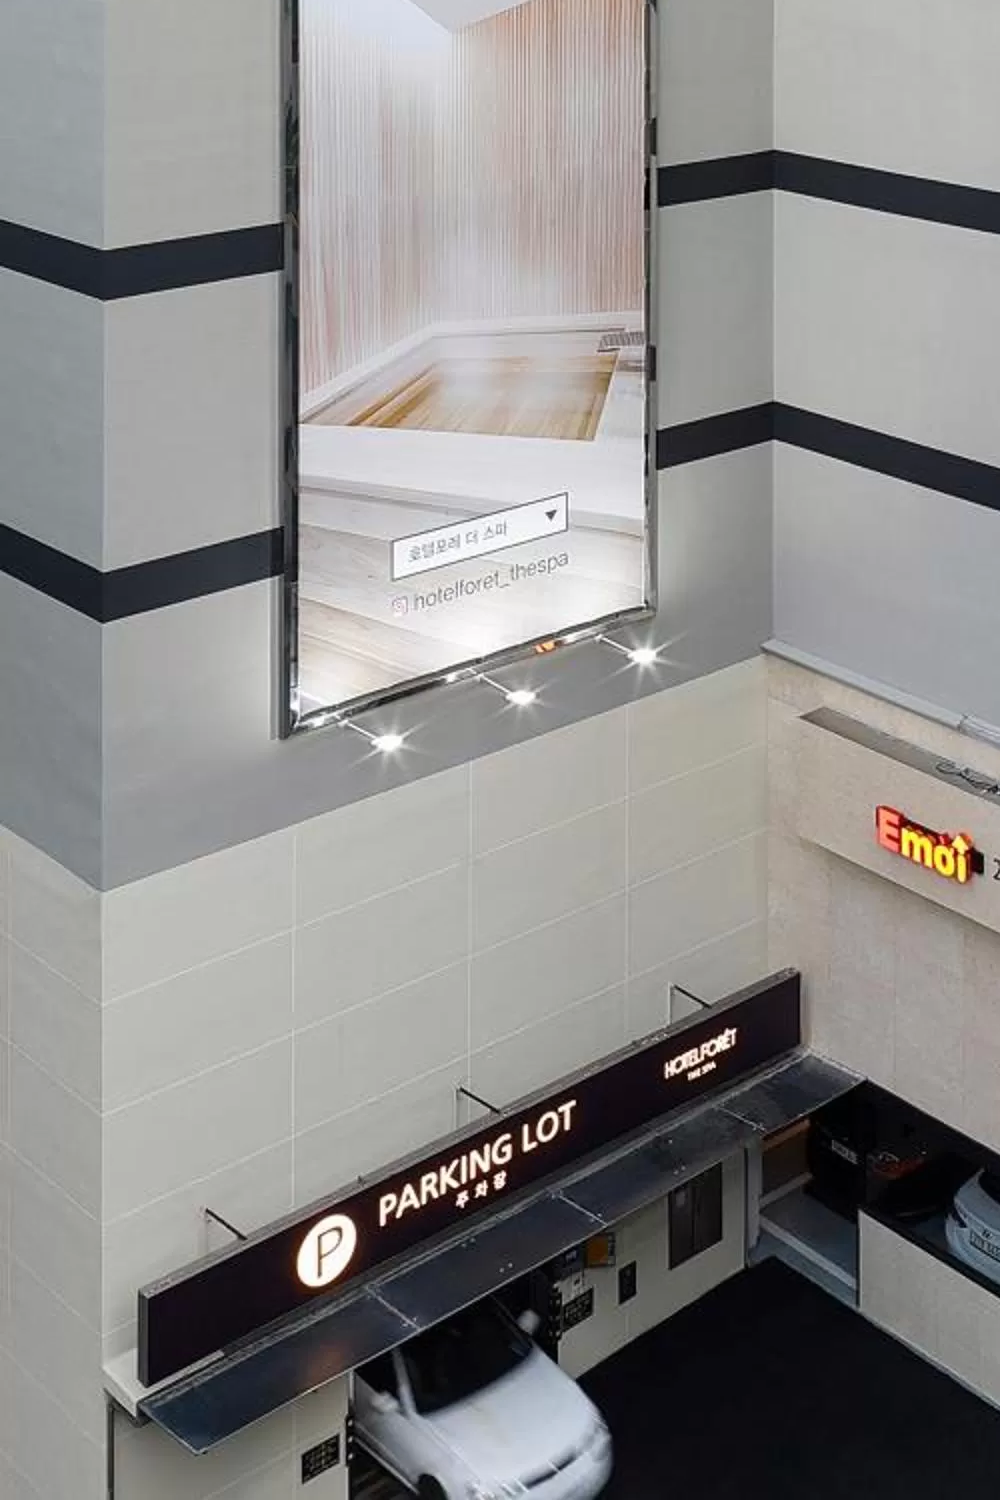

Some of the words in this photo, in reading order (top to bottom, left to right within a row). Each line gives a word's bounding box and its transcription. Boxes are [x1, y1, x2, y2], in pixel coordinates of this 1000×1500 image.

[413, 550, 569, 612] hotelforet_thespa
[378, 1132, 513, 1228] PARKING
[521, 1099, 577, 1153] LOT
[316, 1225, 343, 1279] P
